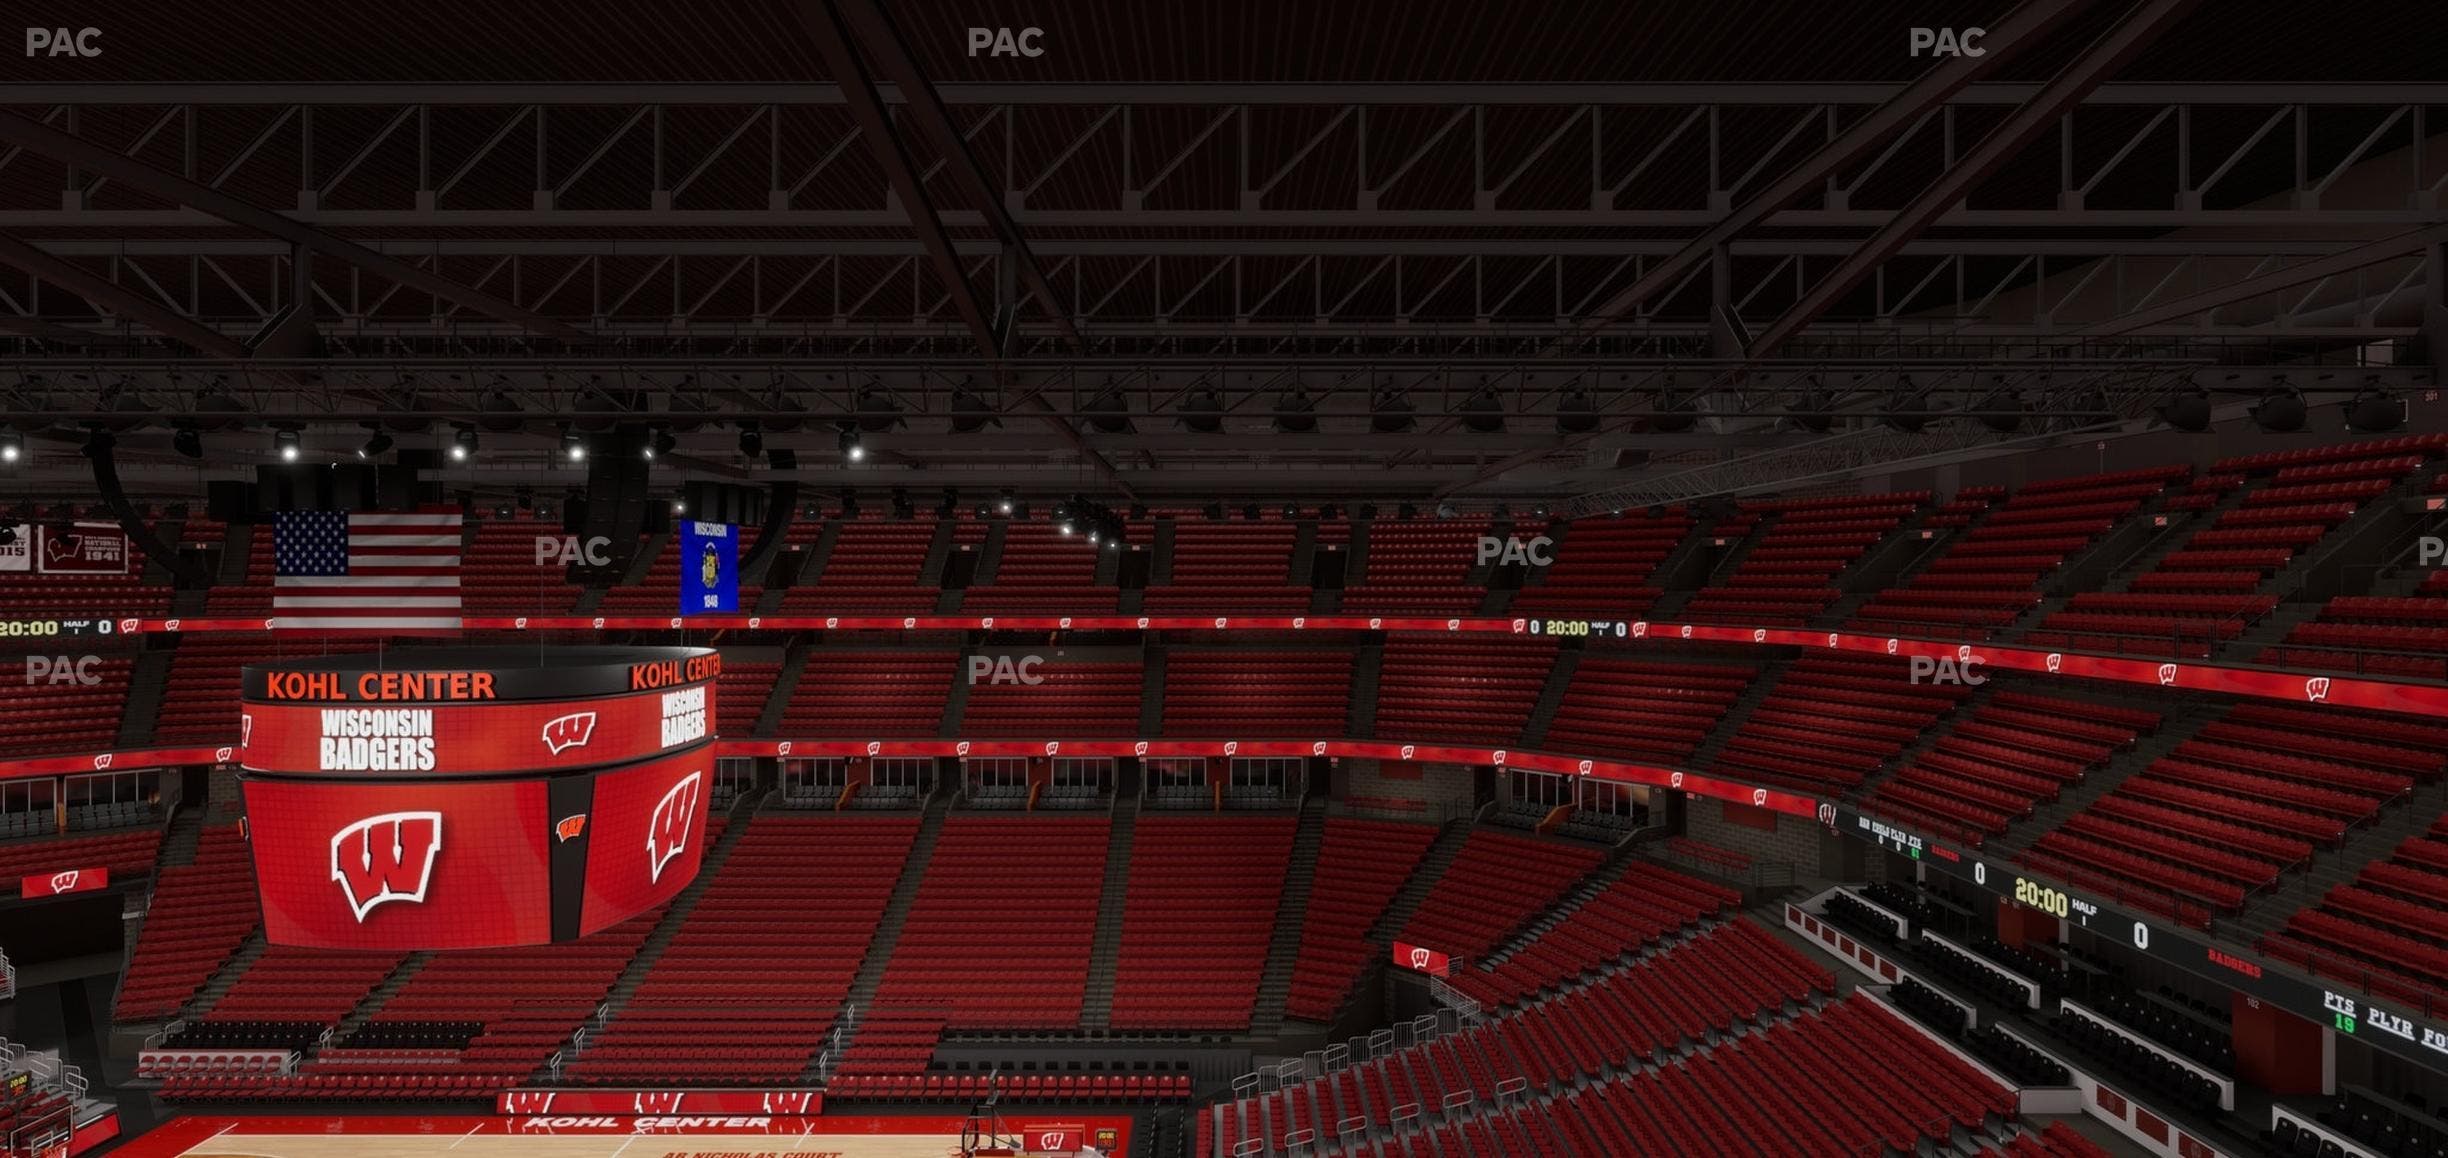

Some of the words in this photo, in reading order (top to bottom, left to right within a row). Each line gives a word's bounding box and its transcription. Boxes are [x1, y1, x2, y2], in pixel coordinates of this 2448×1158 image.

[85, 551, 120, 561] 1941
[0, 620, 58, 636] 20:00
[64, 620, 90, 628] HALF
[98, 620, 112, 634] 0
[1530, 620, 1540, 635] 0
[1547, 620, 1589, 636] 20:00
[1591, 621, 1611, 630] HALF
[1616, 622, 1627, 637] 0
[267, 671, 347, 700] KOHL
[358, 671, 496, 700] CENTER
[632, 660, 684, 690] KOHL
[686, 653, 721, 682] CENTER
[661, 686, 706, 718] WISCONSIN
[321, 709, 433, 737] WISCONSIN
[542, 711, 597, 756] W
[661, 709, 707, 749] BADGERS
[320, 737, 436, 771] BADGERS
[646, 770, 702, 885] W
[331, 811, 443, 924] W
[1975, 862, 1986, 885] 0
[2015, 877, 2068, 918] 20:00
[2072, 898, 2098, 916] HALF
[2133, 921, 2149, 950] 0
[2208, 949, 2262, 979] BADGERS
[2247, 997, 2261, 1010] 102
[2324, 991, 2356, 1013] PTS
[2369, 1008, 2414, 1036] PLYR
[2423, 1028, 2448, 1050] FO
[2335, 1013, 2356, 1034] 19
[524, 1117, 619, 1128] KOHL
[632, 1117, 771, 1128] CENTER
